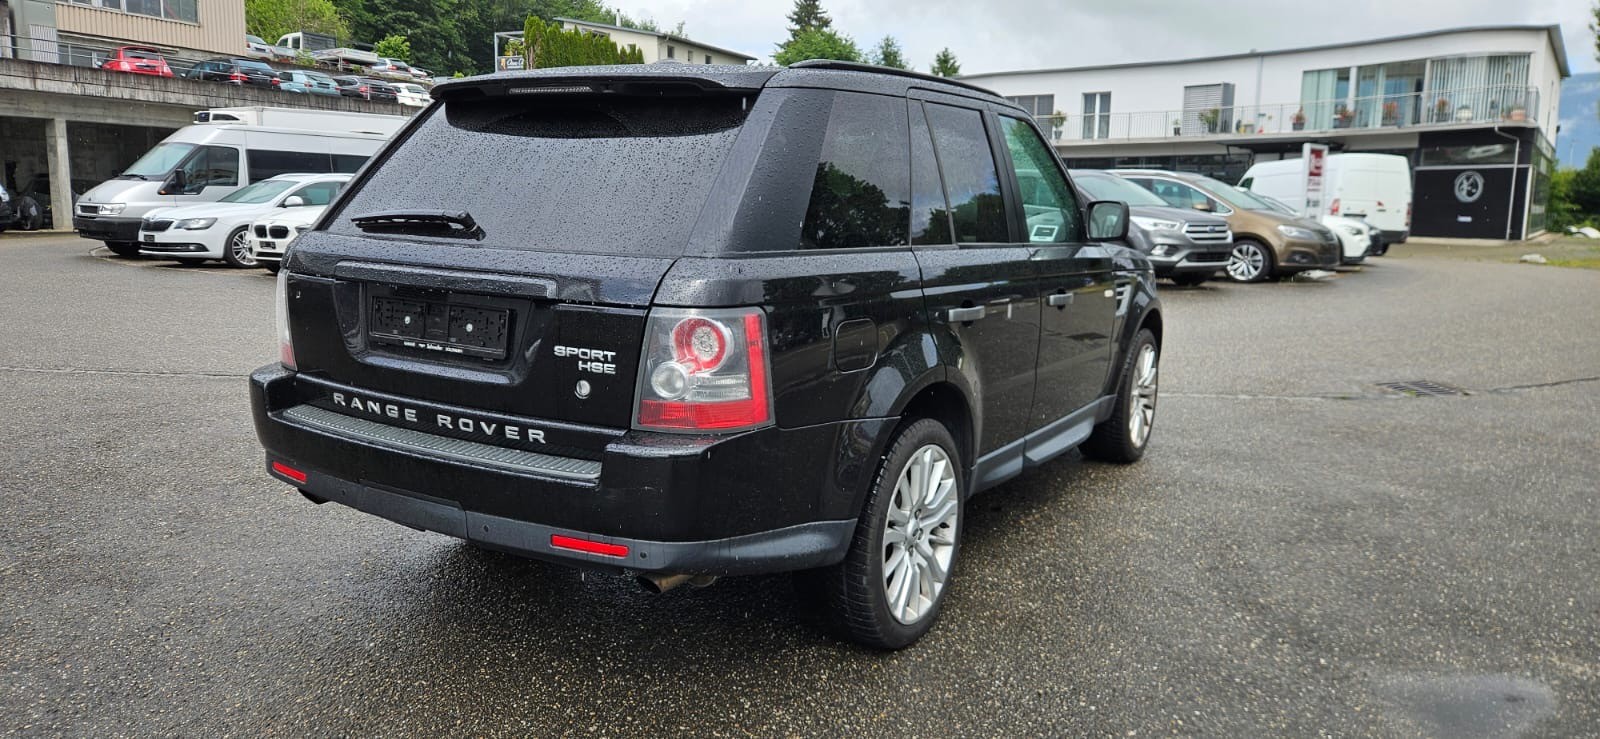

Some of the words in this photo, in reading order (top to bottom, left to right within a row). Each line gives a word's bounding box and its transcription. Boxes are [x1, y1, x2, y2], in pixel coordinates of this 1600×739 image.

[553, 345, 616, 362] SPORT
[578, 360, 616, 375] HSE
[332, 391, 418, 422] RANGE
[437, 414, 547, 444] ROVER
